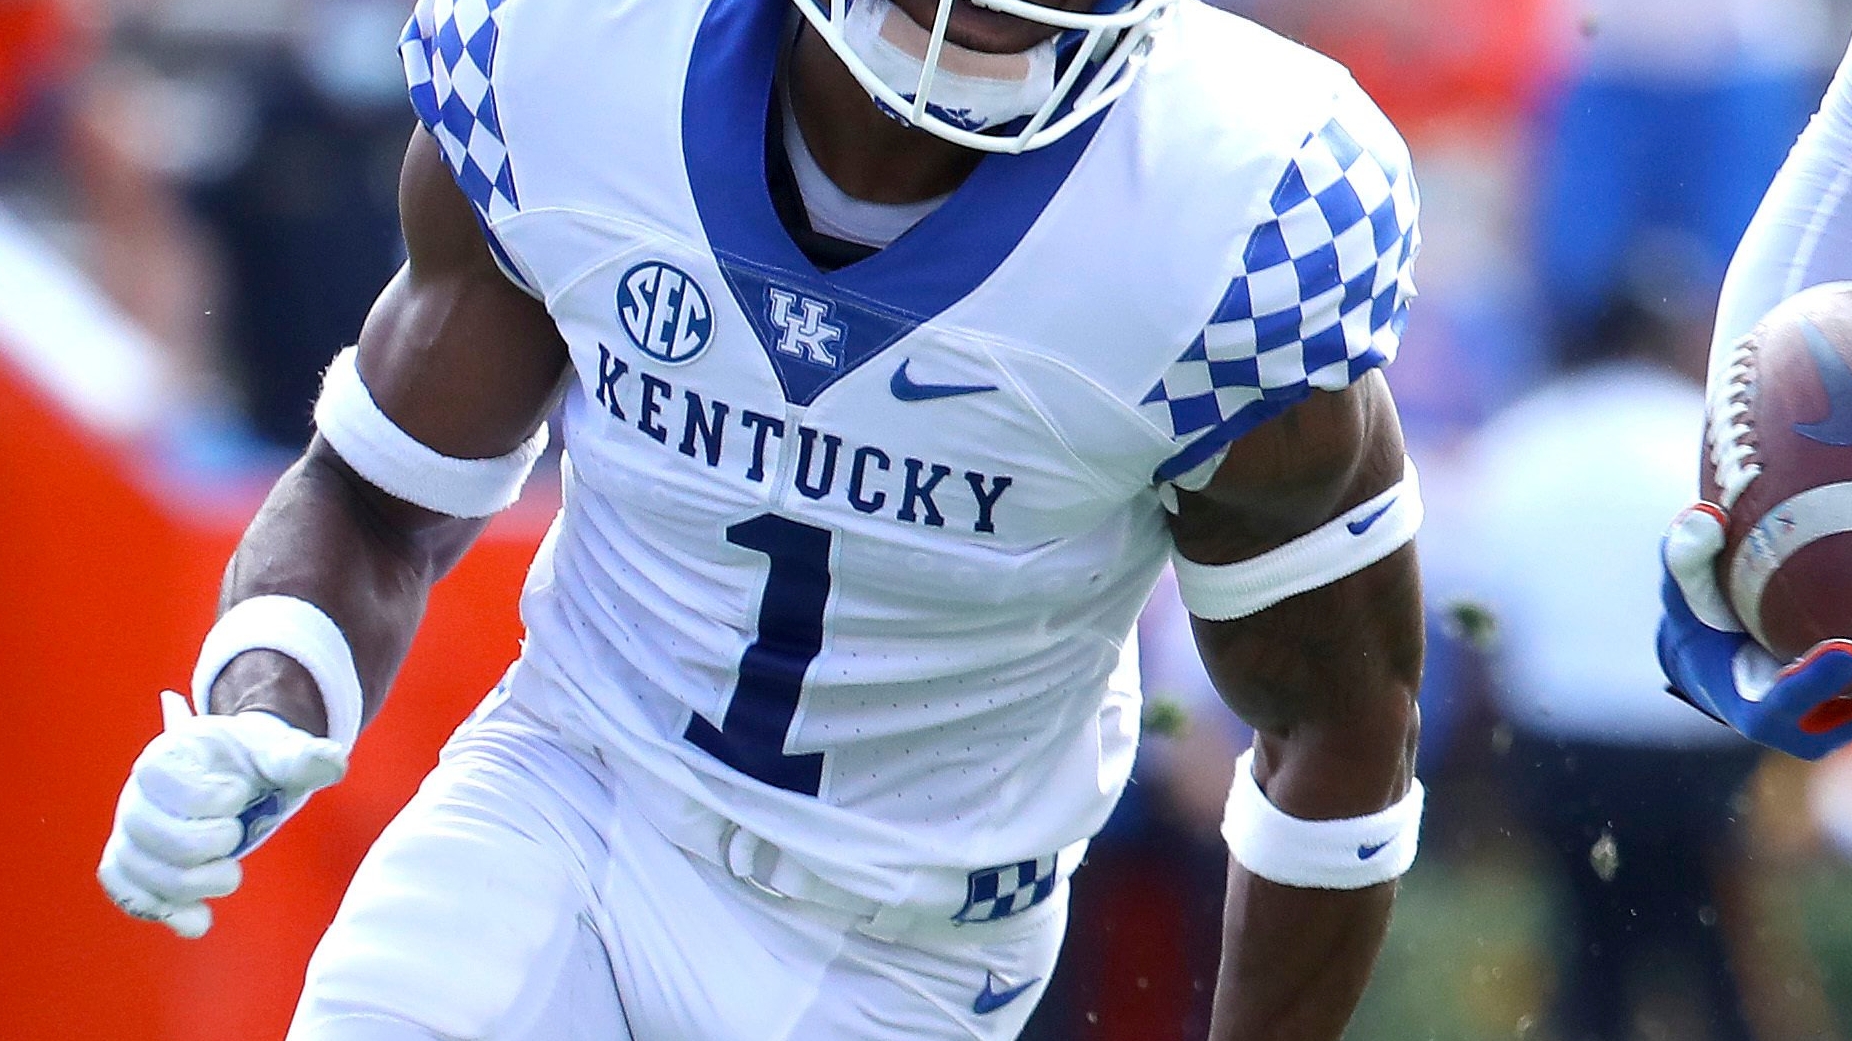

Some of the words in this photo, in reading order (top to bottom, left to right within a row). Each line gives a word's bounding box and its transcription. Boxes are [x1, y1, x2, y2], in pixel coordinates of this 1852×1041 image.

[622, 266, 707, 358] SEC
[769, 287, 841, 368] UK
[597, 342, 1012, 533] KENTUCKY
[684, 512, 833, 798] 1
